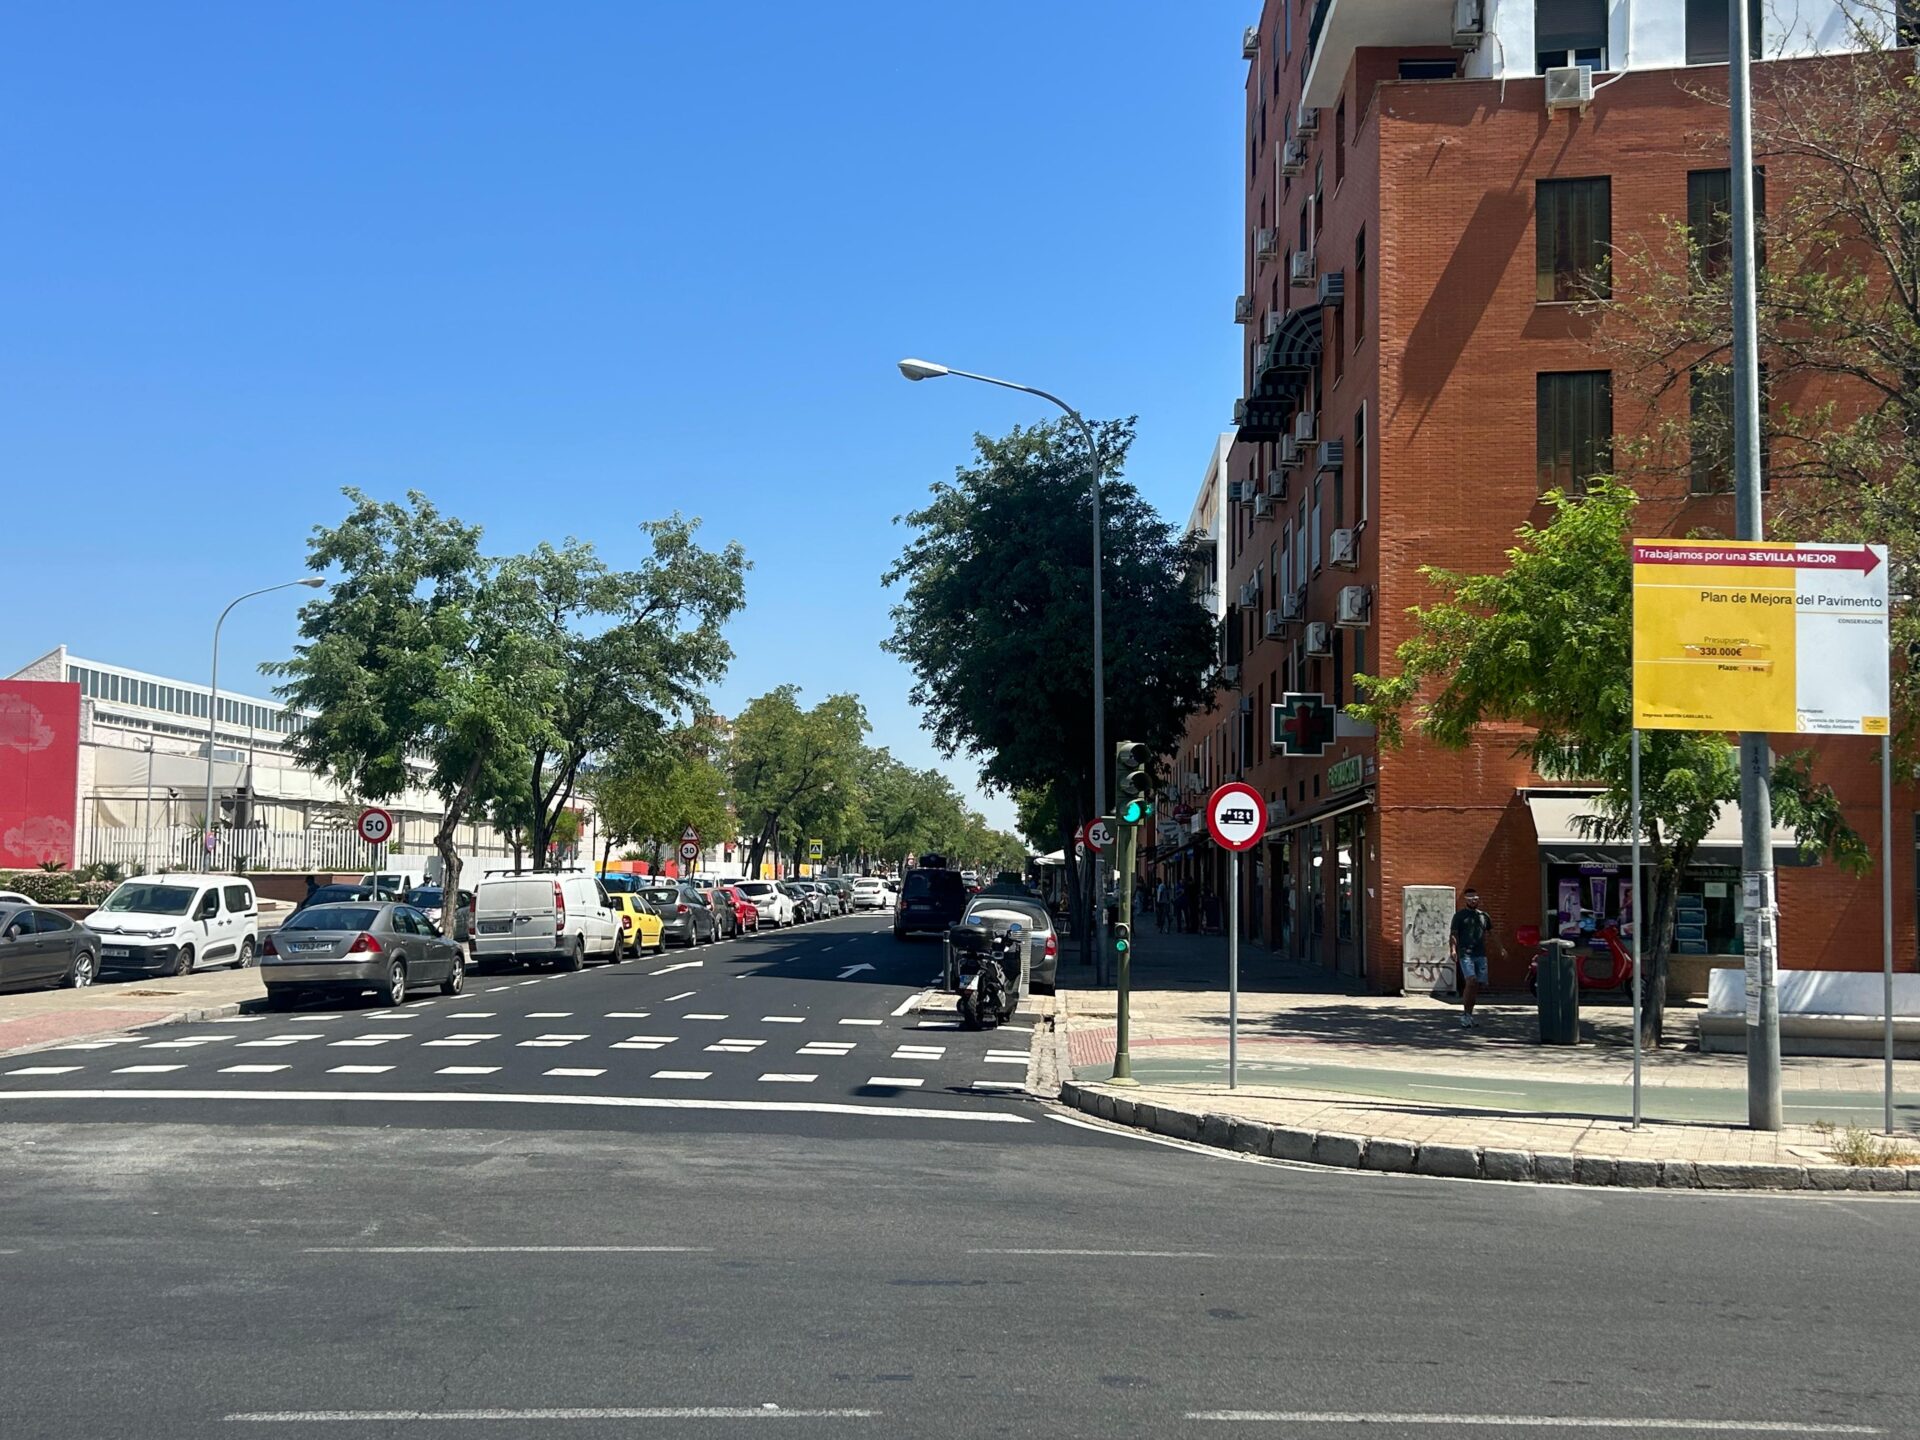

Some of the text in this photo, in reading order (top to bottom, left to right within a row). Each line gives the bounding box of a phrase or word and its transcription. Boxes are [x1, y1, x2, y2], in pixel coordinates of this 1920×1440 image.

[1638, 548, 1837, 564] Trabajamos por una SEVILLA MEJOR
[1700, 591, 1883, 607] Plan de Mejora del Pavimento
[1704, 636, 1750, 645] Presupuesto
[1700, 647, 1743, 656] 330.000€
[1233, 811, 1252, 820] 12 t
[365, 820, 385, 832] 50
[1092, 829, 1111, 841] 50
